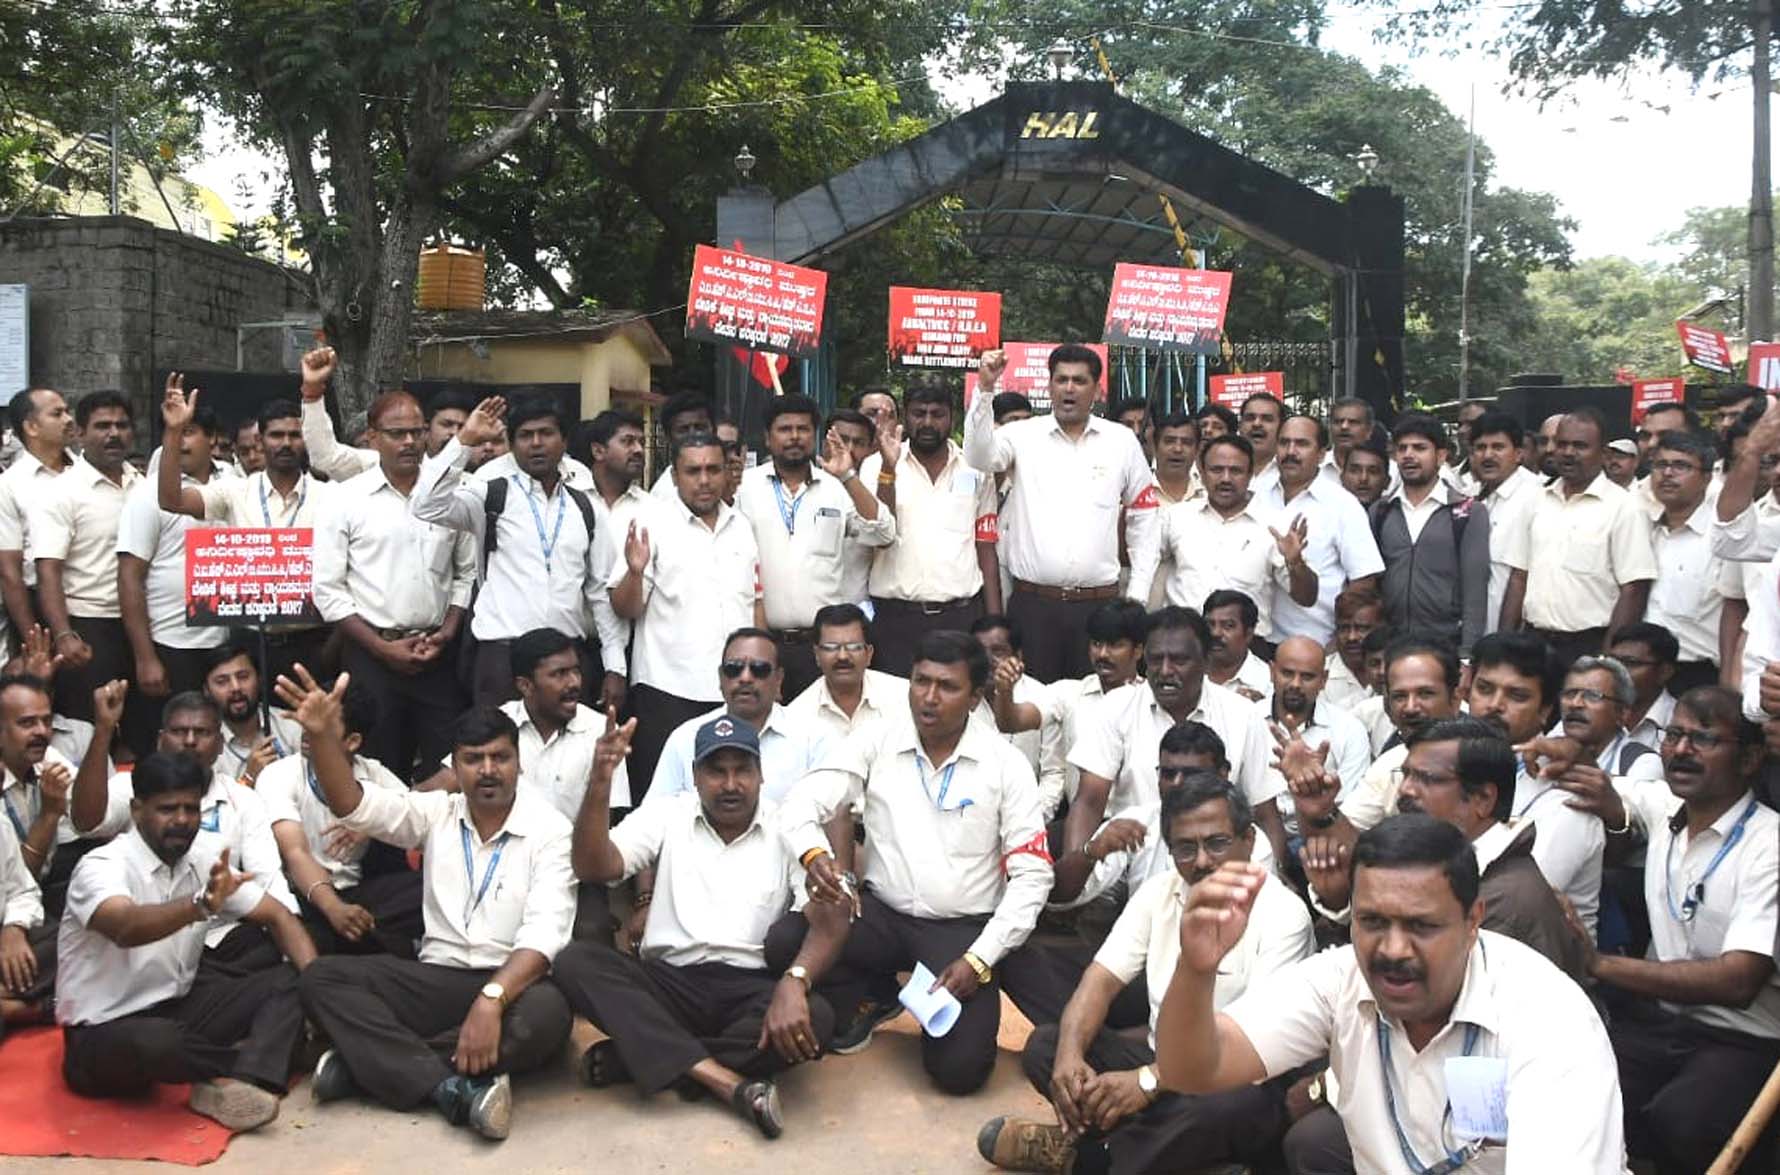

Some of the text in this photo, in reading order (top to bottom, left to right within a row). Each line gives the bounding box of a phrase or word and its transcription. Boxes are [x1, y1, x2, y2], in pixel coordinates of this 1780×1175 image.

[1020, 112, 1099, 139] HAL
[967, 359, 981, 367] 201
[215, 534, 271, 543] 14-10-2019
[281, 602, 303, 614] 2017
